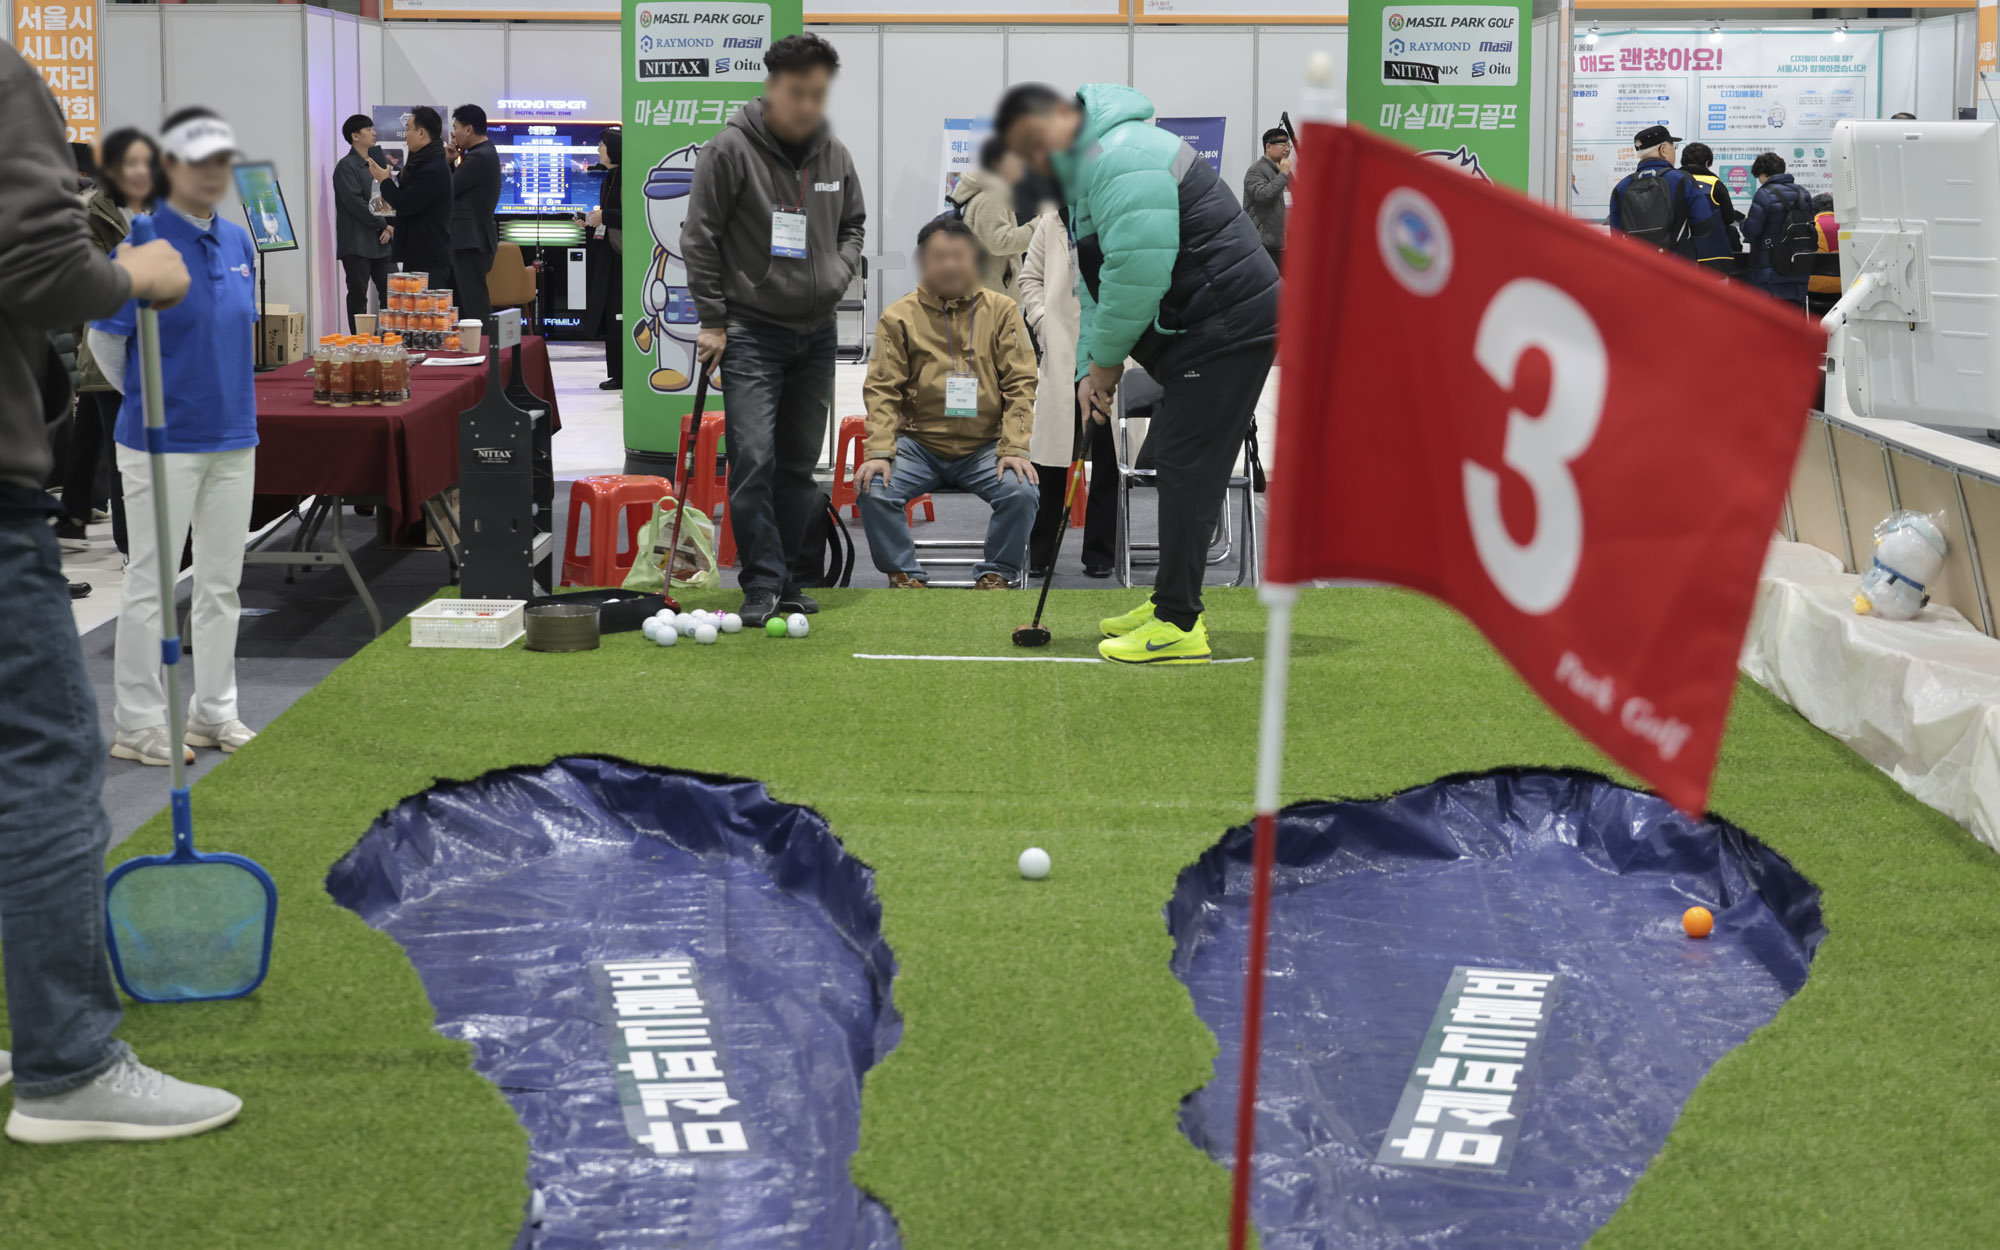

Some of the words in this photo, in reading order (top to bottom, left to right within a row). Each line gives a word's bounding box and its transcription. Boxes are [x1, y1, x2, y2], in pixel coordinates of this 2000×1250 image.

[18, 5, 93, 31] 서울시
[653, 13, 690, 25] MASIL
[693, 13, 730, 25] PARK
[732, 14, 765, 25] GOLF
[1405, 17, 1448, 28] MASIL
[1450, 17, 1486, 28] PARK
[1487, 17, 1515, 29] GOLF
[21, 35, 94, 61] 시니어
[656, 38, 714, 48] RAYMOND
[1409, 42, 1471, 52] RAYMOND
[645, 60, 702, 76] NITTAX
[734, 58, 761, 71] Oita
[1579, 55, 1615, 73] 해도
[1619, 47, 1723, 72] 괜찮아요!
[1391, 63, 1435, 81] NITTAX
[1488, 62, 1511, 75] Oita
[37, 65, 94, 91] 자리
[497, 99, 545, 109] STRONG
[546, 100, 587, 110] FISHER
[1379, 103, 1518, 130] 마실파크골프
[478, 449, 512, 458] NITTAX
[1461, 277, 1609, 616] 3
[1554, 650, 1615, 715] Park
[1619, 696, 1693, 763] Golf
